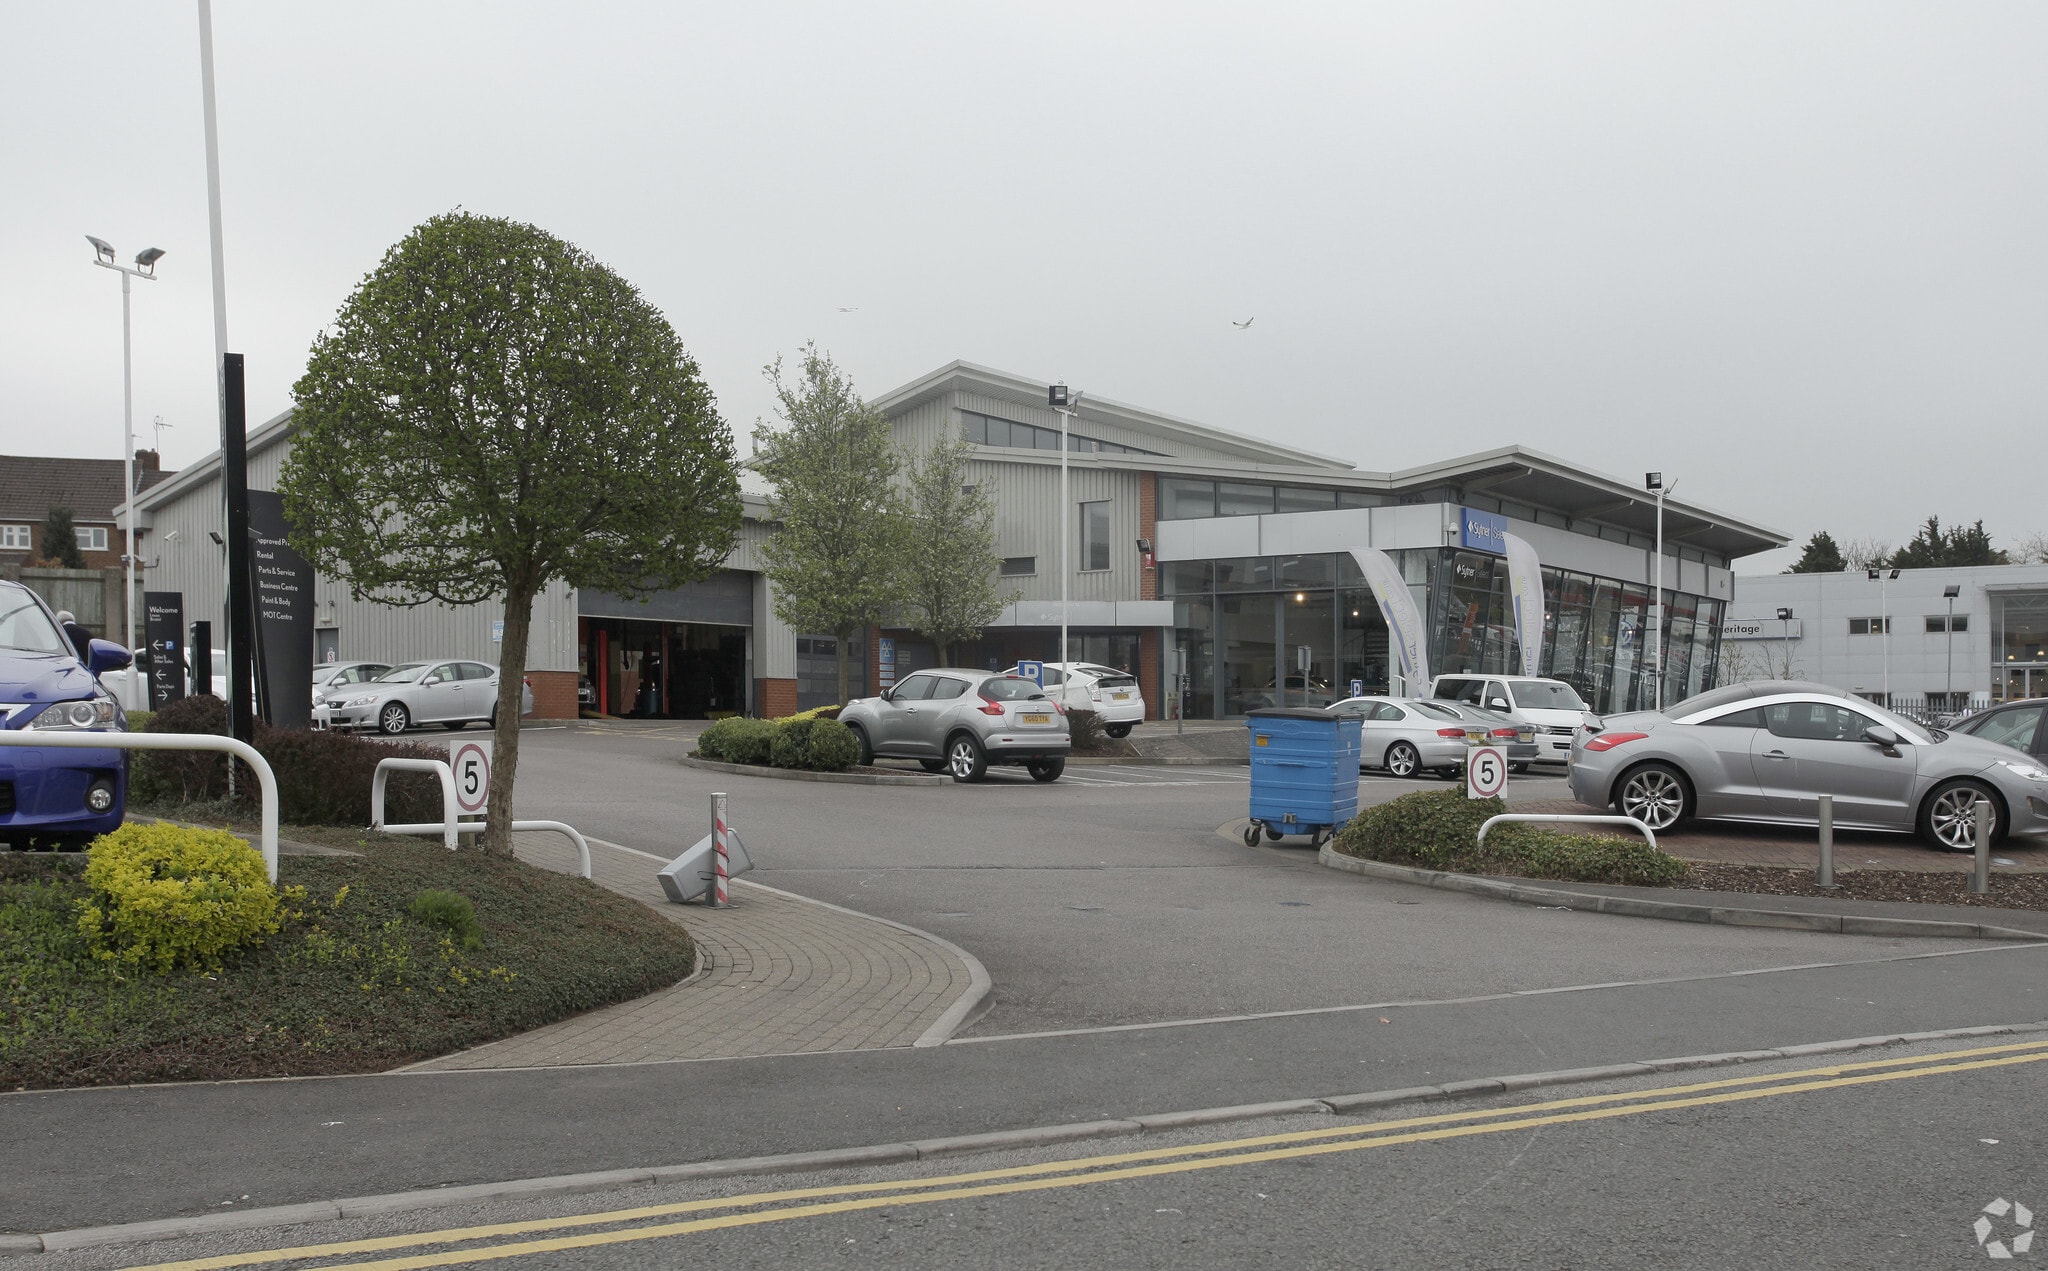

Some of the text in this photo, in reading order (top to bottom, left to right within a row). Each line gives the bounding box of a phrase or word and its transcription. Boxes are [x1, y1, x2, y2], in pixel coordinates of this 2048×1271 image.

[1473, 522, 1490, 538] Sytner
[256, 550, 274, 560] Rental
[258, 565, 296, 577] Parts & Service
[1461, 564, 1475, 578] Sytner
[260, 580, 299, 592] Business Centre
[261, 595, 291, 607] Paint & Body
[149, 606, 178, 614] Welcome
[263, 610, 292, 621] MOT Centre
[1724, 624, 1760, 635] eritage
[166, 641, 173, 649] P
[1024, 664, 1039, 679] P
[1353, 683, 1360, 697] P
[465, 760, 478, 795] 5
[1481, 760, 1494, 785] 5
